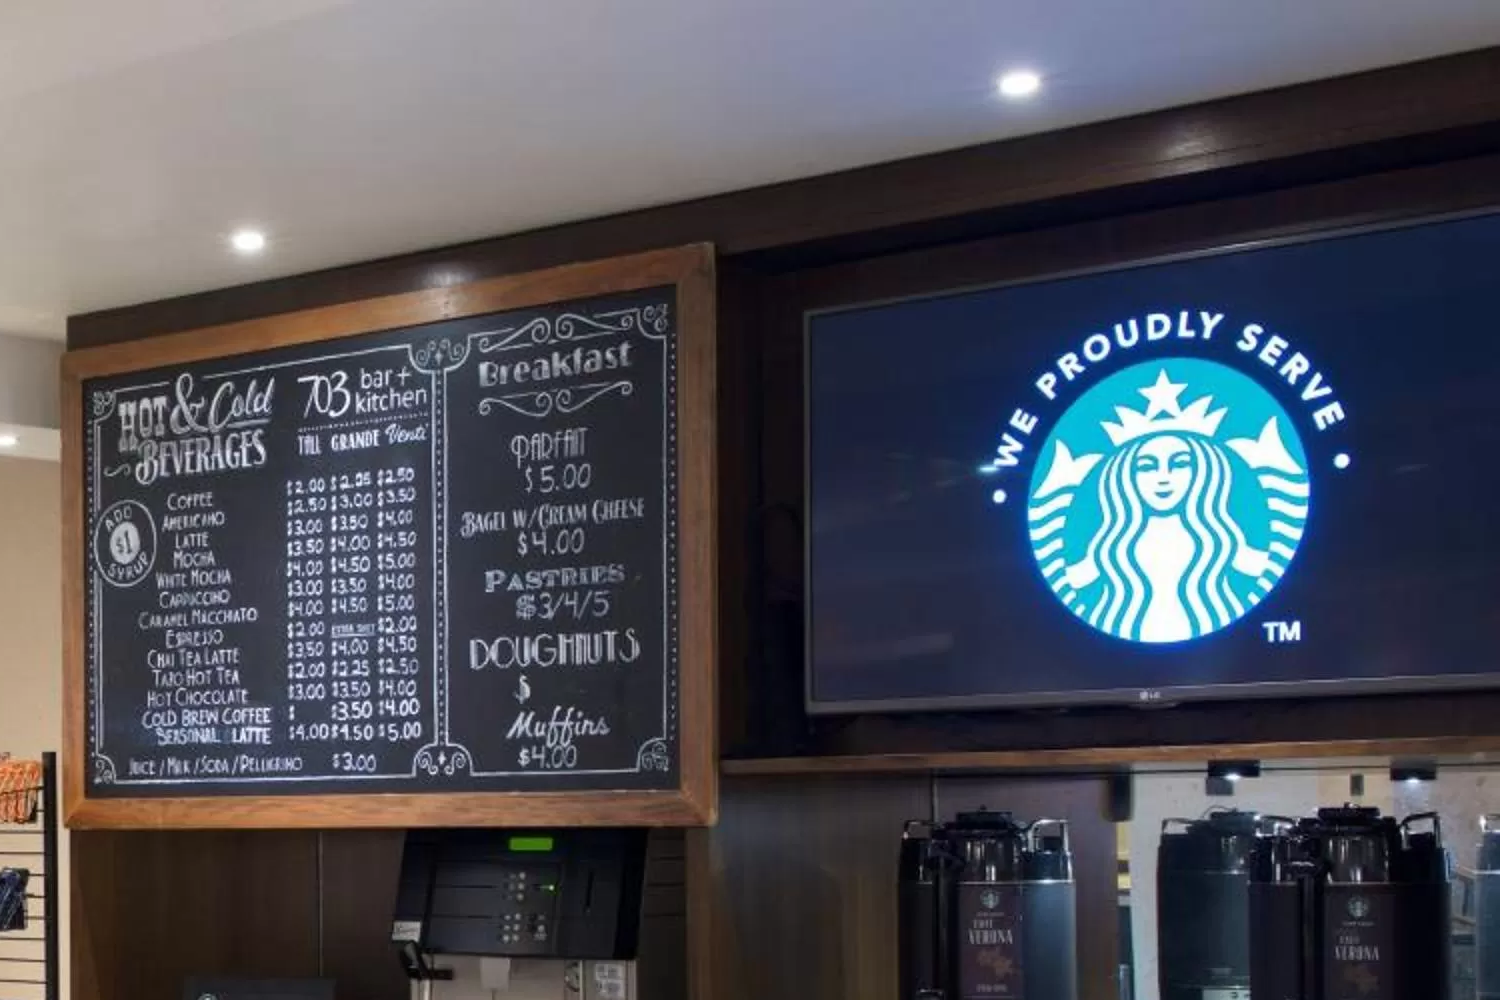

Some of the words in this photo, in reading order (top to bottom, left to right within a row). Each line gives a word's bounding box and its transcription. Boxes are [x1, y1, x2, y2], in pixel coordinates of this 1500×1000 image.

[360, 367, 393, 389] bar
[479, 340, 633, 388] Breakfast
[355, 387, 427, 414] kitchen
[992, 406, 1039, 469] WE
[1035, 310, 1225, 400] PROUDLY
[1236, 323, 1345, 430] SERVE
[118, 396, 168, 452] HOT
[208, 376, 275, 433] Cold
[331, 429, 380, 451] GRANDE
[510, 426, 589, 469] PARFAIT
[135, 428, 267, 485] BEVERAGES
[460, 511, 506, 538] BAGEL
[484, 563, 626, 593] PASTRIES
[1263, 620, 1302, 642] TM
[470, 627, 641, 670] DOUGHNUTS
[141, 709, 178, 729] COLD
[181, 708, 219, 727] BREW
[222, 706, 273, 725] COFFEE
[506, 705, 610, 747] Muffins
[231, 726, 273, 744] LATTE
[517, 745, 577, 768] $4.00
